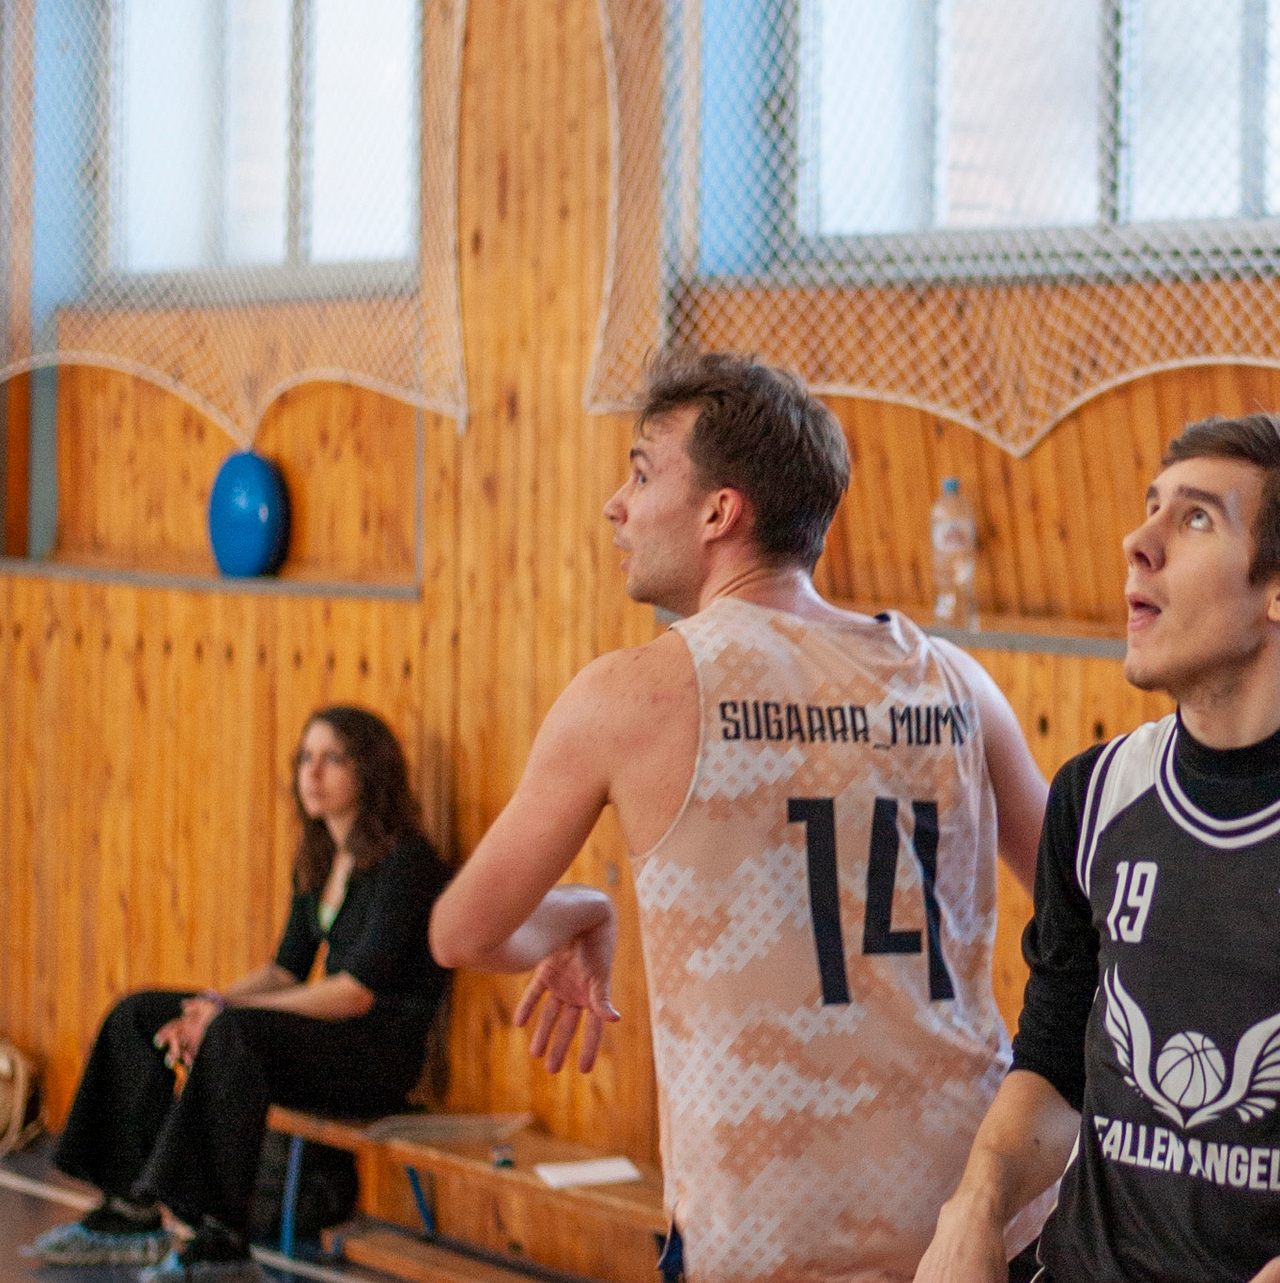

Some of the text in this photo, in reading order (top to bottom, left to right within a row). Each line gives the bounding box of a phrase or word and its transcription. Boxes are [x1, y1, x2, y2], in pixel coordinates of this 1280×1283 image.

[719, 700, 969, 750] SUGARRR_MUM
[788, 797, 955, 1007] 14
[1107, 861, 1158, 943] 19
